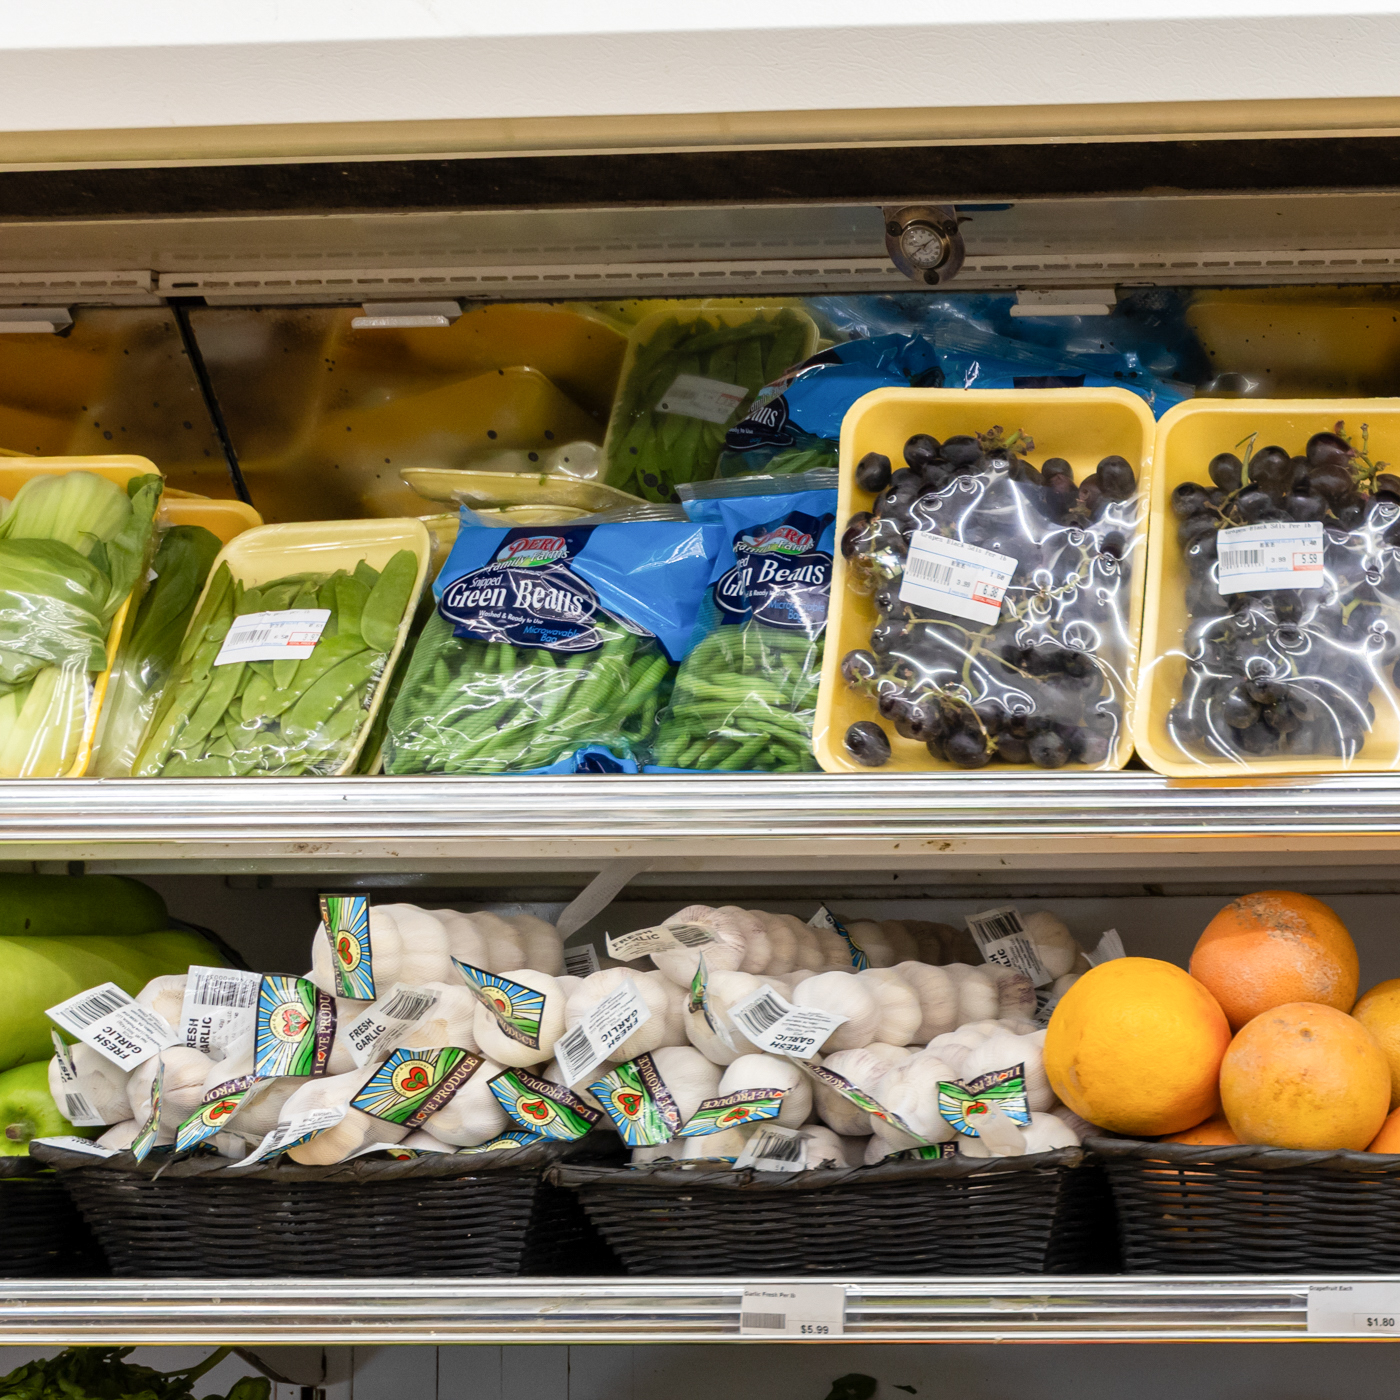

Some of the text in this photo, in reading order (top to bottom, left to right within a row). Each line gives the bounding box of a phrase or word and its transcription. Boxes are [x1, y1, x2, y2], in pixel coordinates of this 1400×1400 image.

[488, 550, 570, 572] Family Farms
[757, 560, 825, 585] Beans
[469, 574, 503, 589] Snipped
[447, 579, 584, 616] Green Beans
[348, 1018, 375, 1041] FRESH
[356, 1025, 386, 1051] GARLIC
[600, 1009, 638, 1043] GARLIC
[607, 1017, 639, 1049] FRESH
[93, 1033, 130, 1060] FRESH
[102, 1026, 143, 1054] GARLIC
[769, 1041, 808, 1053] FRESH
[774, 1034, 815, 1045] GARLIC
[432, 1057, 478, 1106] PRODUCE
[702, 1090, 755, 1109] PRODUCE
[801, 1324, 829, 1334] $5.99
[1367, 1317, 1395, 1327] $1.80
